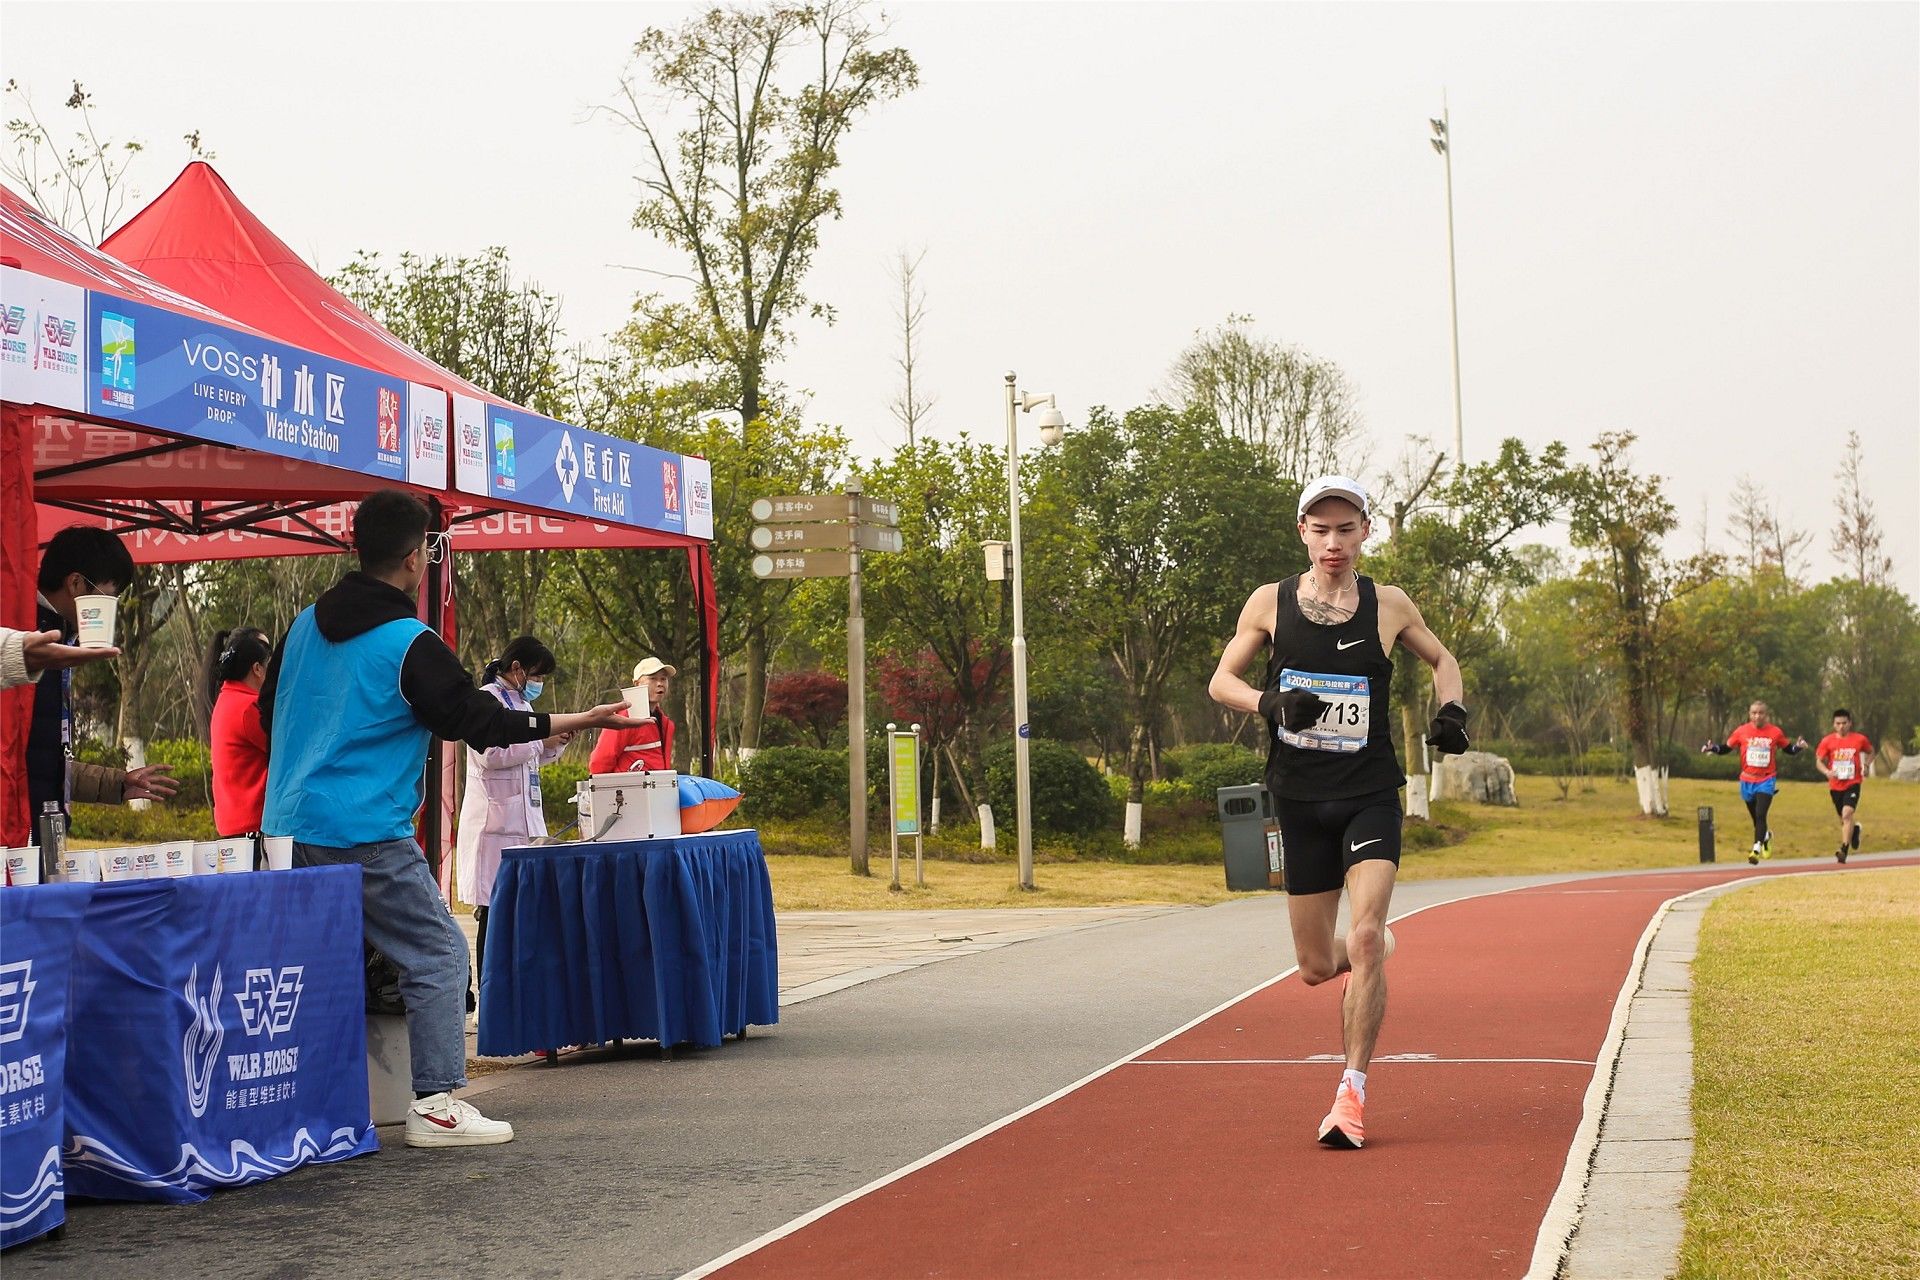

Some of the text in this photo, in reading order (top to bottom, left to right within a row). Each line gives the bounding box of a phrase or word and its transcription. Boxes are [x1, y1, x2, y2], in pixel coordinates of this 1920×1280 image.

[183, 338, 257, 382] VOSS
[194, 383, 247, 408] LIVE EVERY
[261, 353, 345, 425] 补水区
[266, 411, 300, 444] Water
[302, 419, 339, 454] Station
[584, 442, 632, 488] 医疗区
[593, 487, 625, 517] First Aid
[775, 557, 806, 569] 停车场
[227, 1046, 299, 1081] WAR HORSE
[225, 1081, 297, 1110] 能量型维生素饮料
